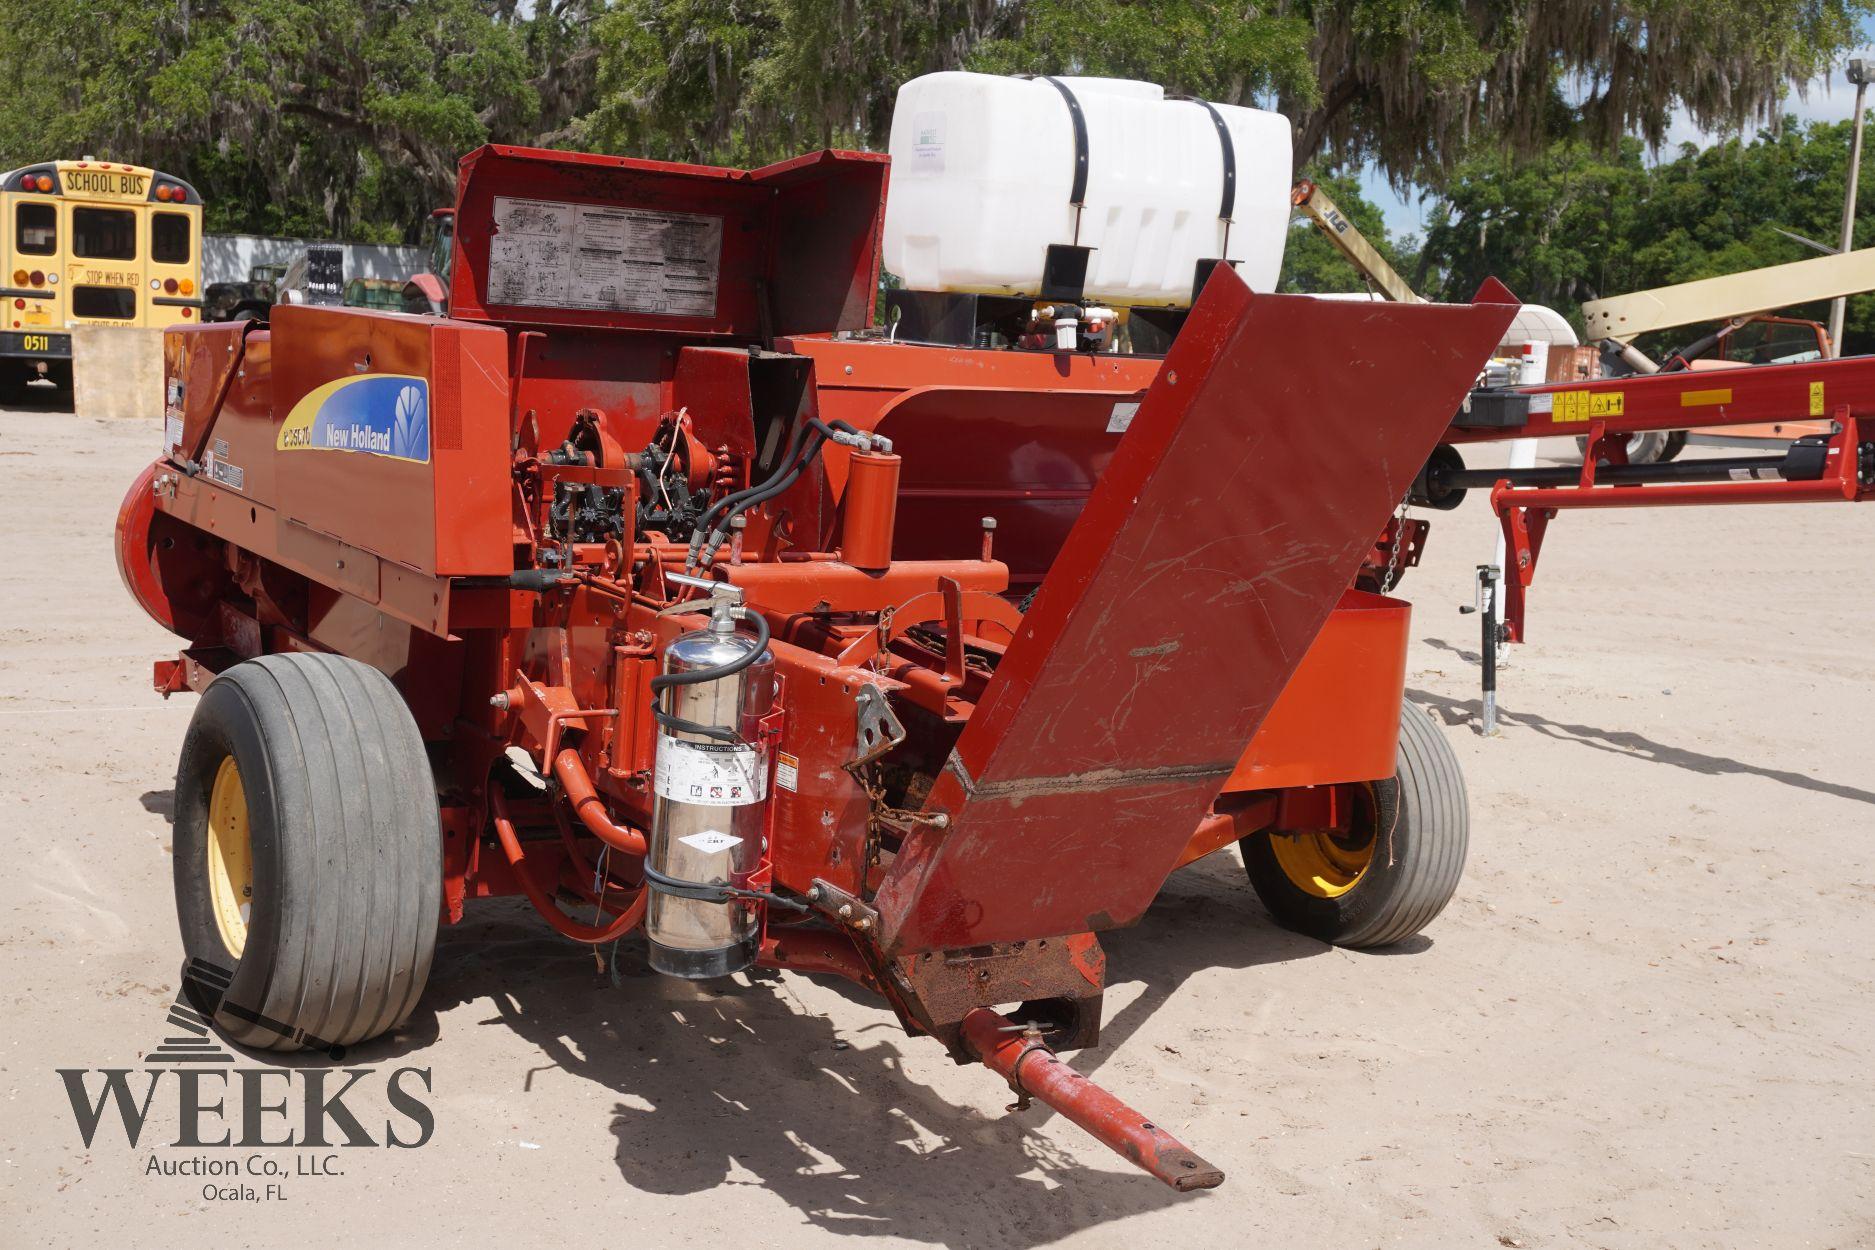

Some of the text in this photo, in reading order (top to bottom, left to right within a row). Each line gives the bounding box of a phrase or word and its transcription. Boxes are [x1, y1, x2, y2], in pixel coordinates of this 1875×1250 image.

[67, 171, 143, 195] SCHOOL BUS
[1323, 210, 1348, 233] JLG
[86, 269, 139, 286] STOP WHEN RED
[23, 335, 48, 351] 0511
[326, 423, 391, 452] New Holland
[694, 744, 742, 752] INSTRUCTIONS
